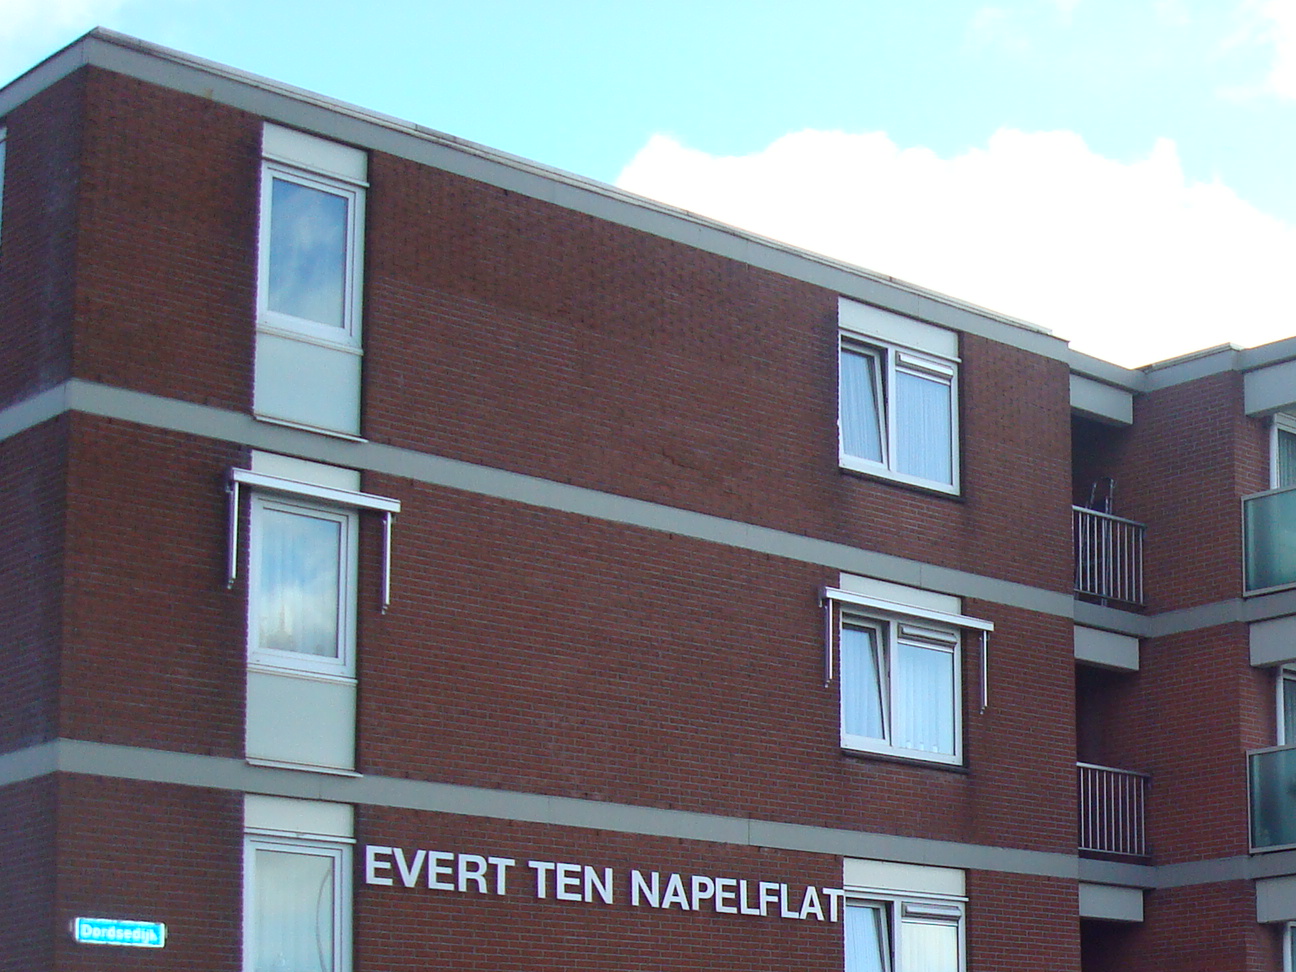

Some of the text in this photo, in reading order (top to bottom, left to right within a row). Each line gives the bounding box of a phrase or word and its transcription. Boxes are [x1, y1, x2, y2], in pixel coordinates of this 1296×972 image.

[365, 844, 844, 923] EVERT TEN NAPELFLAT
[80, 923, 158, 943] Dordsedijk
